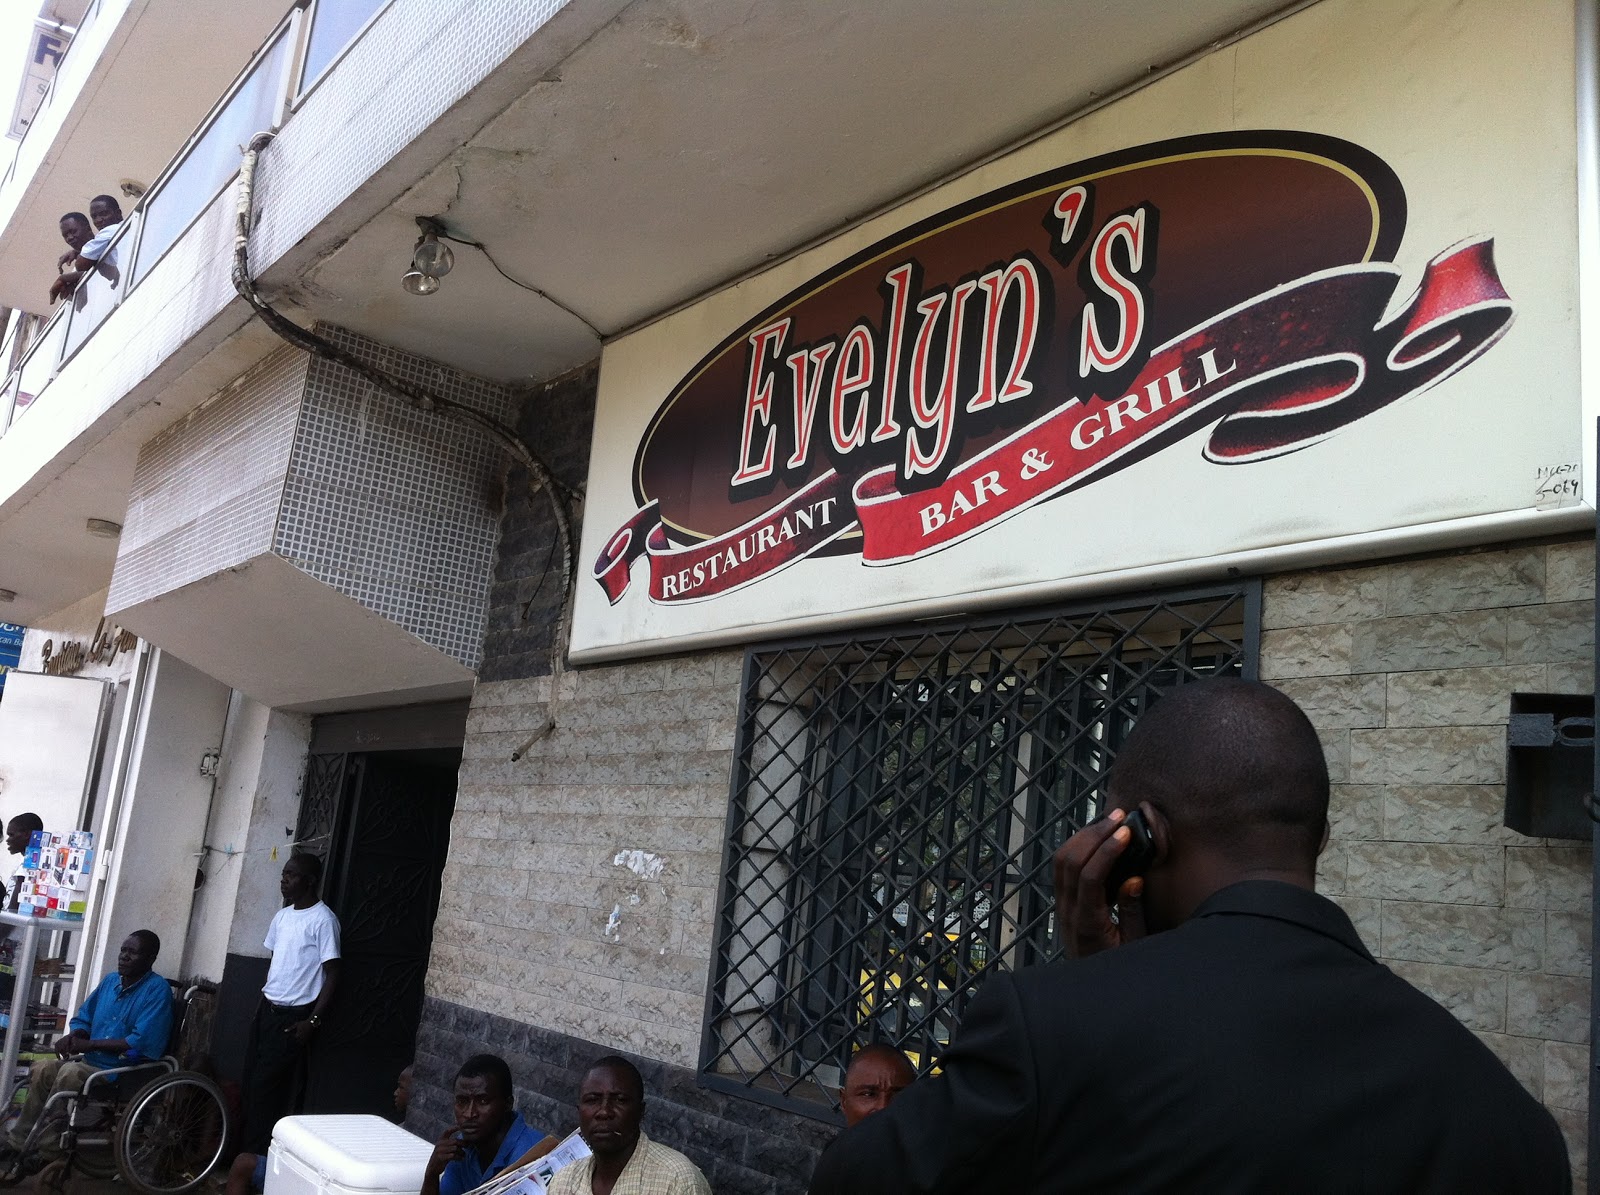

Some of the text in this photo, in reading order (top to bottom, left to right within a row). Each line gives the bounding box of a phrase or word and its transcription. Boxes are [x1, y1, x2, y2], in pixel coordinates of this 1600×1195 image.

[662, 347, 1237, 599] RESTAURANT BAR & GRILL
[731, 186, 1145, 486] Evelyn's
